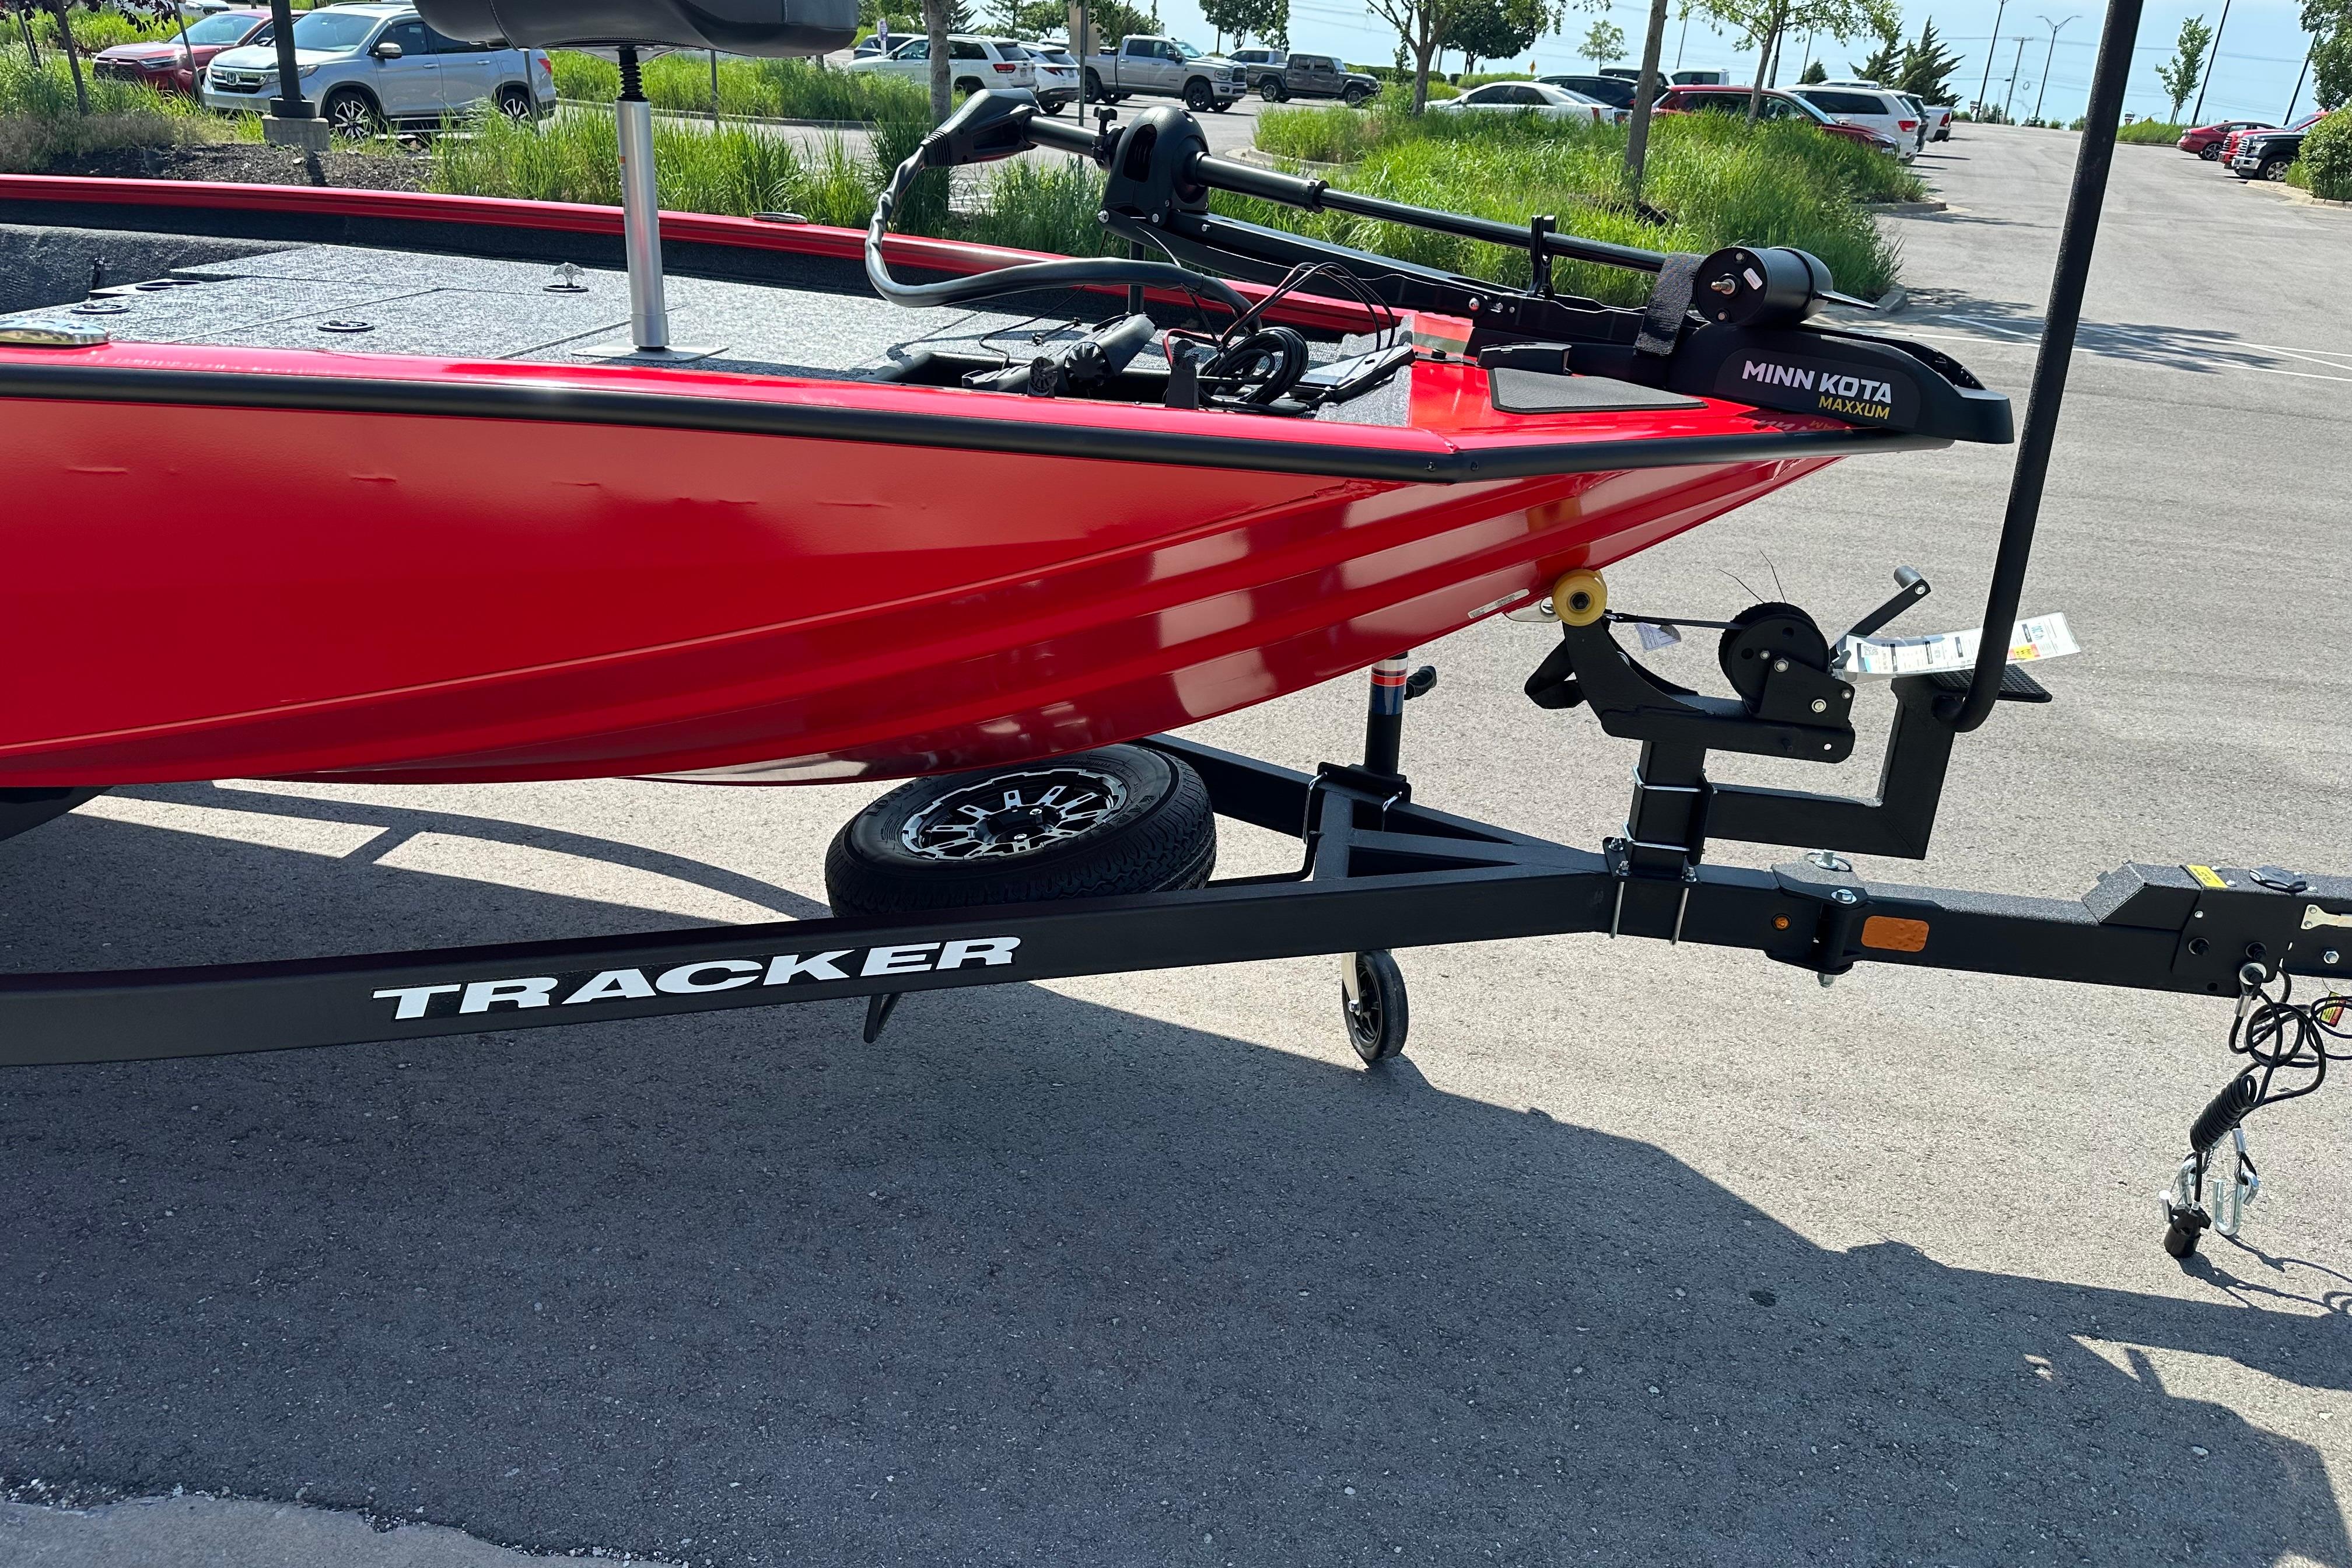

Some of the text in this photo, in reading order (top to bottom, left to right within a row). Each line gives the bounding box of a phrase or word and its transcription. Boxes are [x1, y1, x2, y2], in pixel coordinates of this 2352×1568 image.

[1742, 360, 1892, 404] MINN KOTA
[1818, 396, 1890, 419] MAXXUM
[372, 936, 1021, 1020] TRACKER
